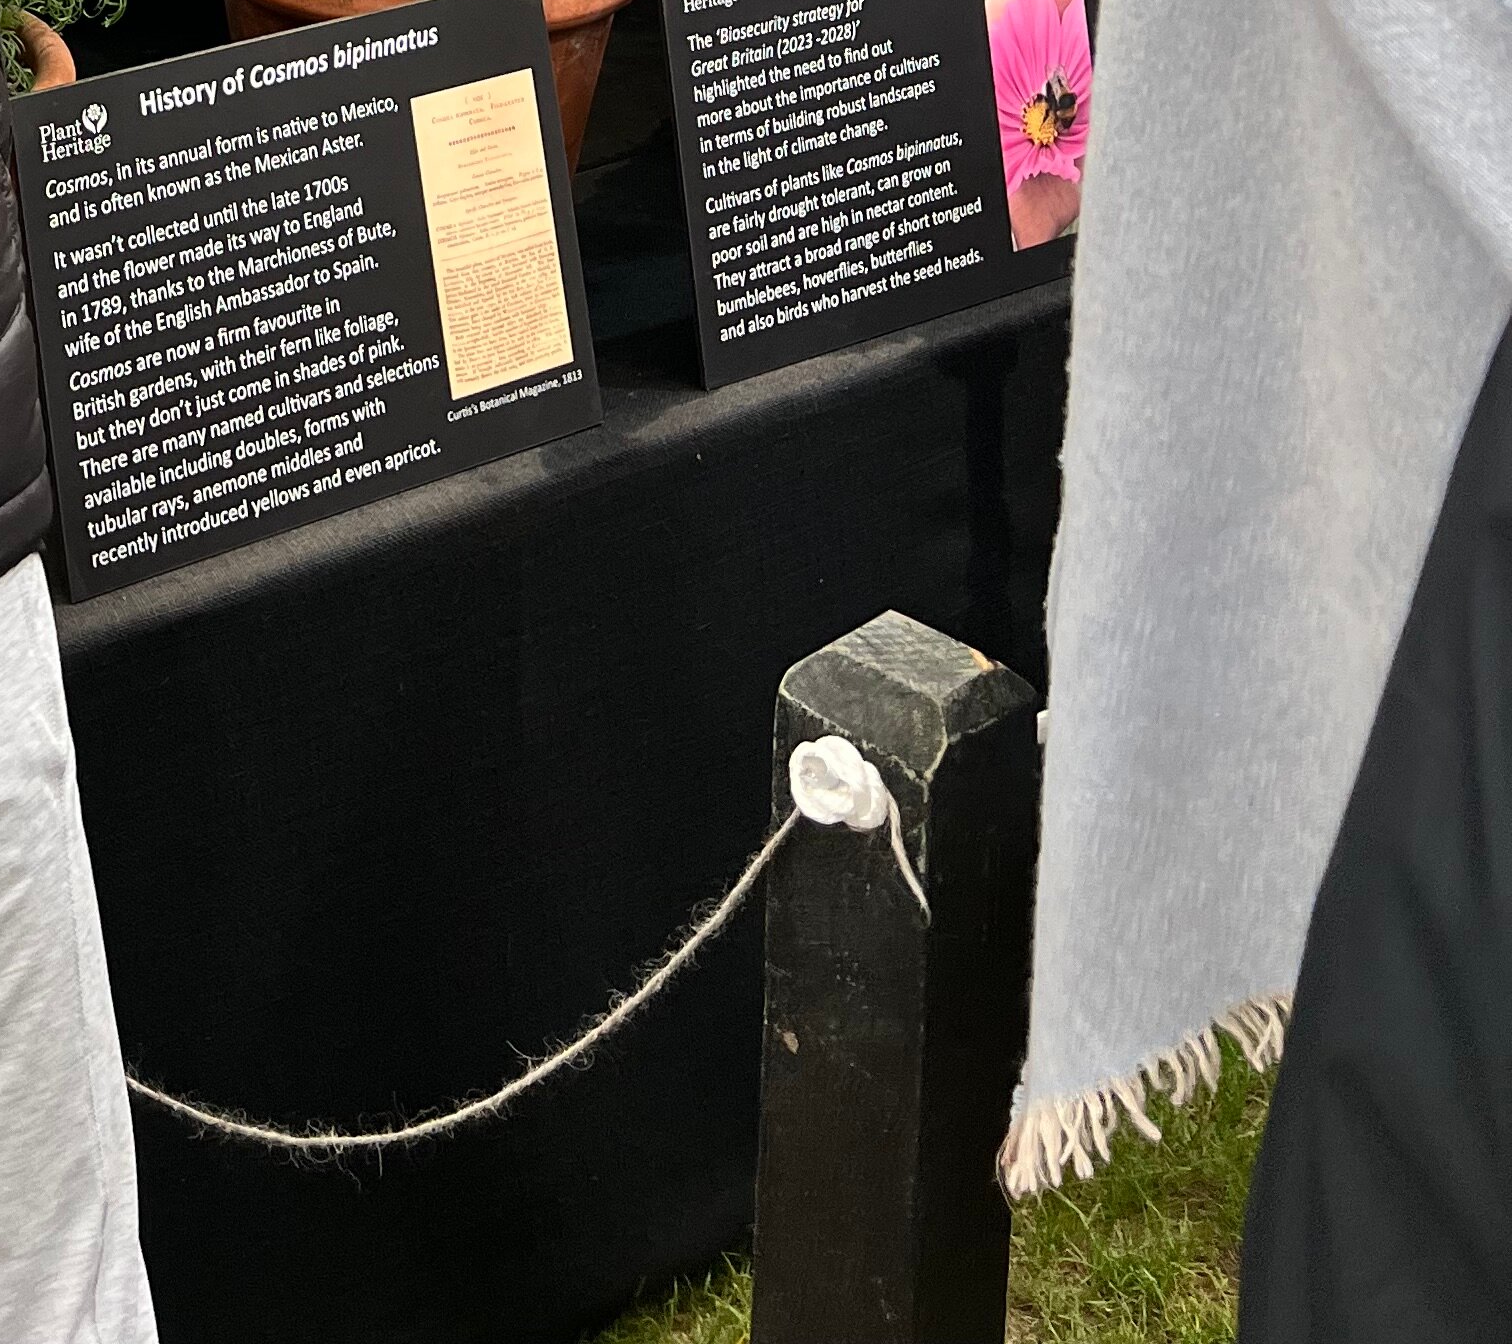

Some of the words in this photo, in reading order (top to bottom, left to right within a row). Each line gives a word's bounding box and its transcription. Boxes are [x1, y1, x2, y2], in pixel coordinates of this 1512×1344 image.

[139, 80, 217, 117] History
[222, 67, 245, 96] of
[249, 53, 329, 89] Cosmos
[333, 26, 439, 70] bipinnatus
[686, 33, 713, 52] The
[791, 2, 844, 28] strategy
[690, 54, 729, 78] Great
[731, 43, 774, 68] Britain
[776, 32, 813, 60] (2023
[693, 68, 767, 104] highlighted
[768, 65, 791, 84] the
[793, 53, 826, 78] need
[827, 53, 843, 69] to
[843, 42, 869, 65] find
[871, 39, 894, 58] out
[38, 119, 83, 145] Plant
[696, 107, 733, 128] more
[734, 95, 774, 119] about
[774, 89, 798, 108] the
[799, 71, 872, 102] importance
[873, 62, 887, 82] of
[889, 53, 941, 78] cultivars
[40, 133, 112, 163] Heritage
[45, 170, 114, 199] Cosmos,
[115, 162, 133, 181] in
[134, 157, 156, 176] its
[158, 138, 213, 170] annual
[214, 133, 254, 156] form
[255, 126, 270, 145] is
[272, 116, 319, 141] native
[320, 111, 339, 128] to
[340, 96, 399, 123] Mexico,
[48, 202, 81, 229] and
[83, 200, 98, 220] is
[100, 191, 144, 215] often
[146, 175, 201, 203] known
[204, 170, 223, 188] as
[223, 161, 252, 182] the
[254, 145, 319, 174] Mexican
[321, 133, 364, 157] Aster.
[705, 187, 763, 214] Cultivars
[764, 178, 778, 198] of
[780, 171, 821, 198] plants
[821, 163, 844, 182] like
[846, 150, 894, 175] Cosmos
[896, 132, 963, 162] bipinnatus,
[53, 251, 68, 270] It
[127, 212, 200, 250] collected
[203, 201, 239, 230] until
[241, 197, 269, 219] the
[270, 190, 301, 211] late
[303, 175, 349, 202] 1700s
[60, 309, 78, 329] in
[81, 295, 128, 323] 1789,
[129, 279, 185, 309] thanks
[186, 275, 205, 293] to
[207, 265, 235, 287] the
[238, 238, 336, 278] Marchioness
[337, 227, 354, 250] of
[356, 222, 397, 244] Bute,
[716, 281, 801, 317] bumblebees,
[802, 260, 869, 291] hoverflies,
[869, 239, 934, 270] butterflies
[720, 318, 746, 342] and
[747, 313, 775, 334] also
[776, 300, 810, 324] birds
[810, 293, 840, 314] who
[840, 277, 889, 304] harvest
[889, 271, 911, 289] the
[913, 258, 943, 282] seed
[943, 248, 984, 272] heads.
[72, 389, 126, 421] British
[129, 372, 198, 408] gardens,
[200, 355, 237, 382] with
[238, 344, 277, 370] their
[279, 336, 313, 358] fern
[314, 325, 342, 348] like
[343, 311, 399, 338] foliage,
[479, 389, 519, 412] Botanical
[518, 379, 562, 399] Magazine,
[561, 368, 583, 385] 1813
[78, 452, 129, 480] There
[131, 443, 159, 464] are
[162, 427, 207, 454] many
[209, 404, 265, 439] named
[267, 388, 332, 420] cultivars
[334, 373, 364, 400] and
[366, 354, 440, 390] selections
[87, 506, 148, 539] tubular
[151, 494, 190, 518] rays,
[193, 467, 268, 505] anemone
[270, 446, 332, 479] middles
[334, 431, 364, 458] and
[92, 531, 158, 569] recently
[160, 498, 249, 545] introduced
[250, 483, 311, 519] yellows
[312, 467, 343, 494] and
[344, 459, 383, 483] even
[384, 438, 442, 471] apricot.
